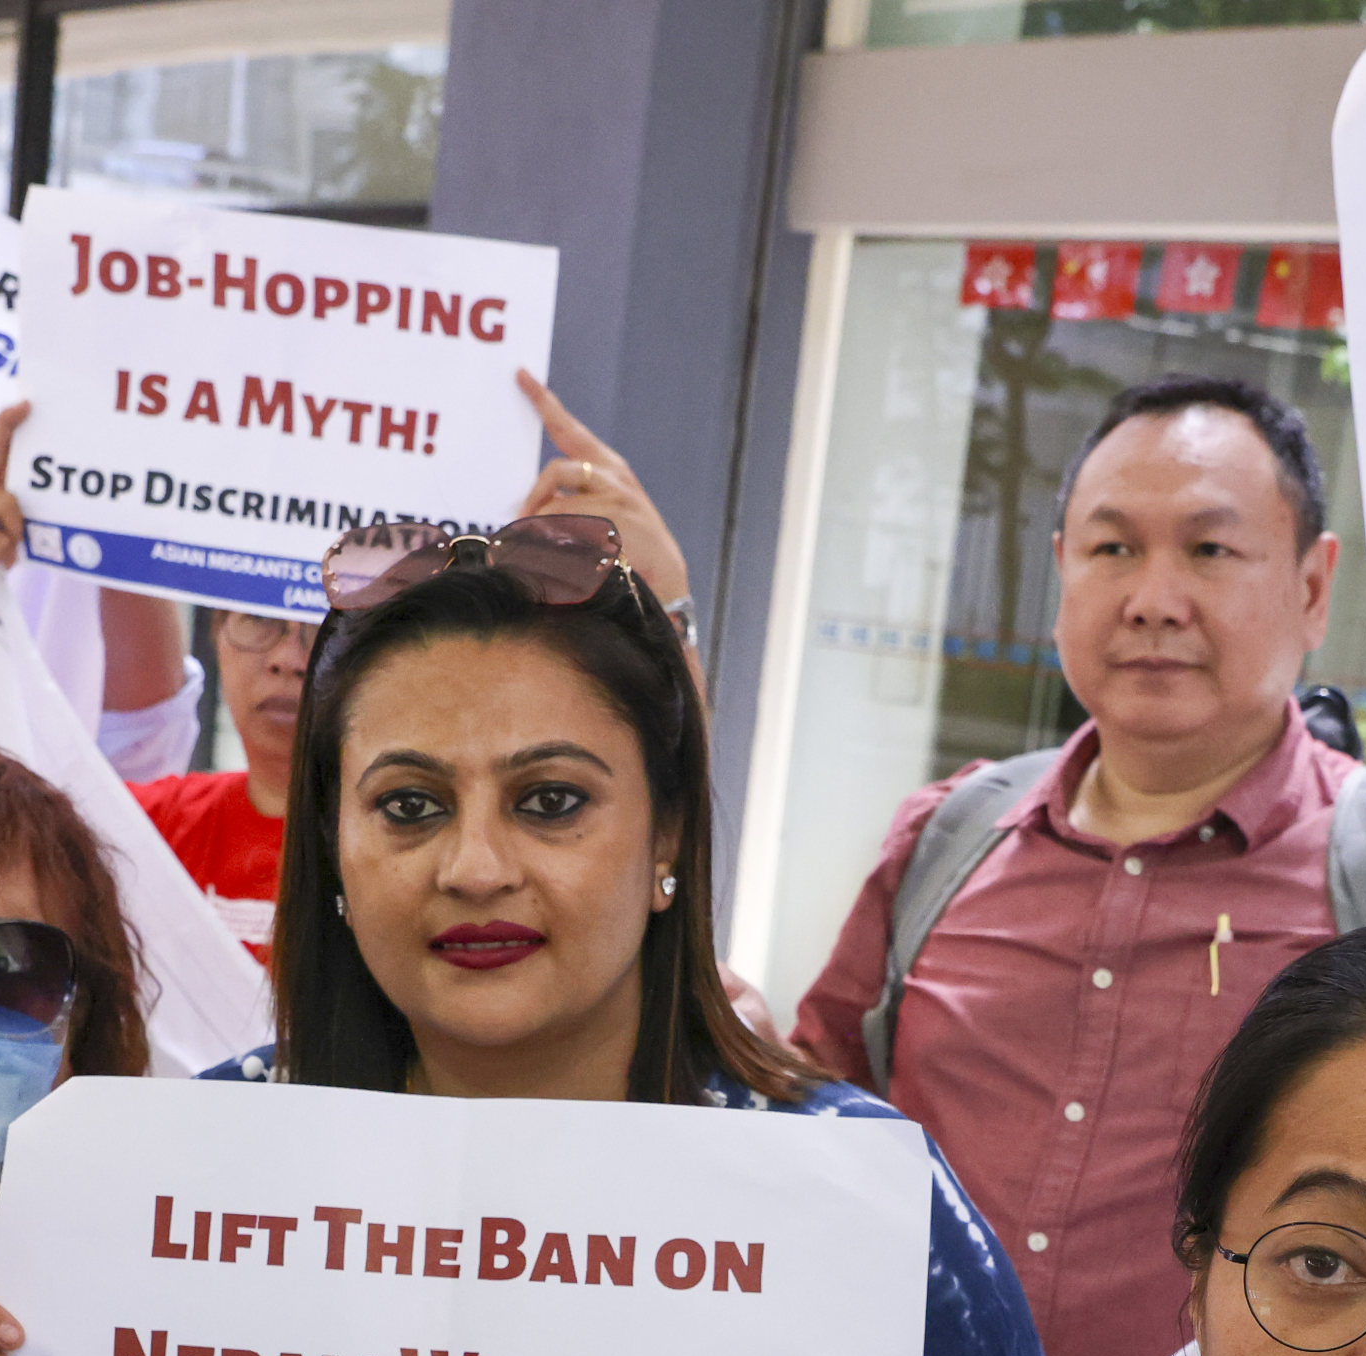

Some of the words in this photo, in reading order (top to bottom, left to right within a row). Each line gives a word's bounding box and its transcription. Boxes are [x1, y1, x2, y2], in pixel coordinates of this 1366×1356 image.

[71, 232, 509, 344] JOB-HOPPING
[114, 369, 169, 415] IS
[186, 379, 221, 424] A
[237, 375, 440, 455] MYTH!
[30, 455, 133, 499] STOP
[145, 470, 496, 547] DISCRIMINATION
[150, 1195, 298, 1268] LIFT
[313, 1205, 464, 1280] THE
[477, 1216, 637, 1288] BAN
[654, 1237, 765, 1294] ON
